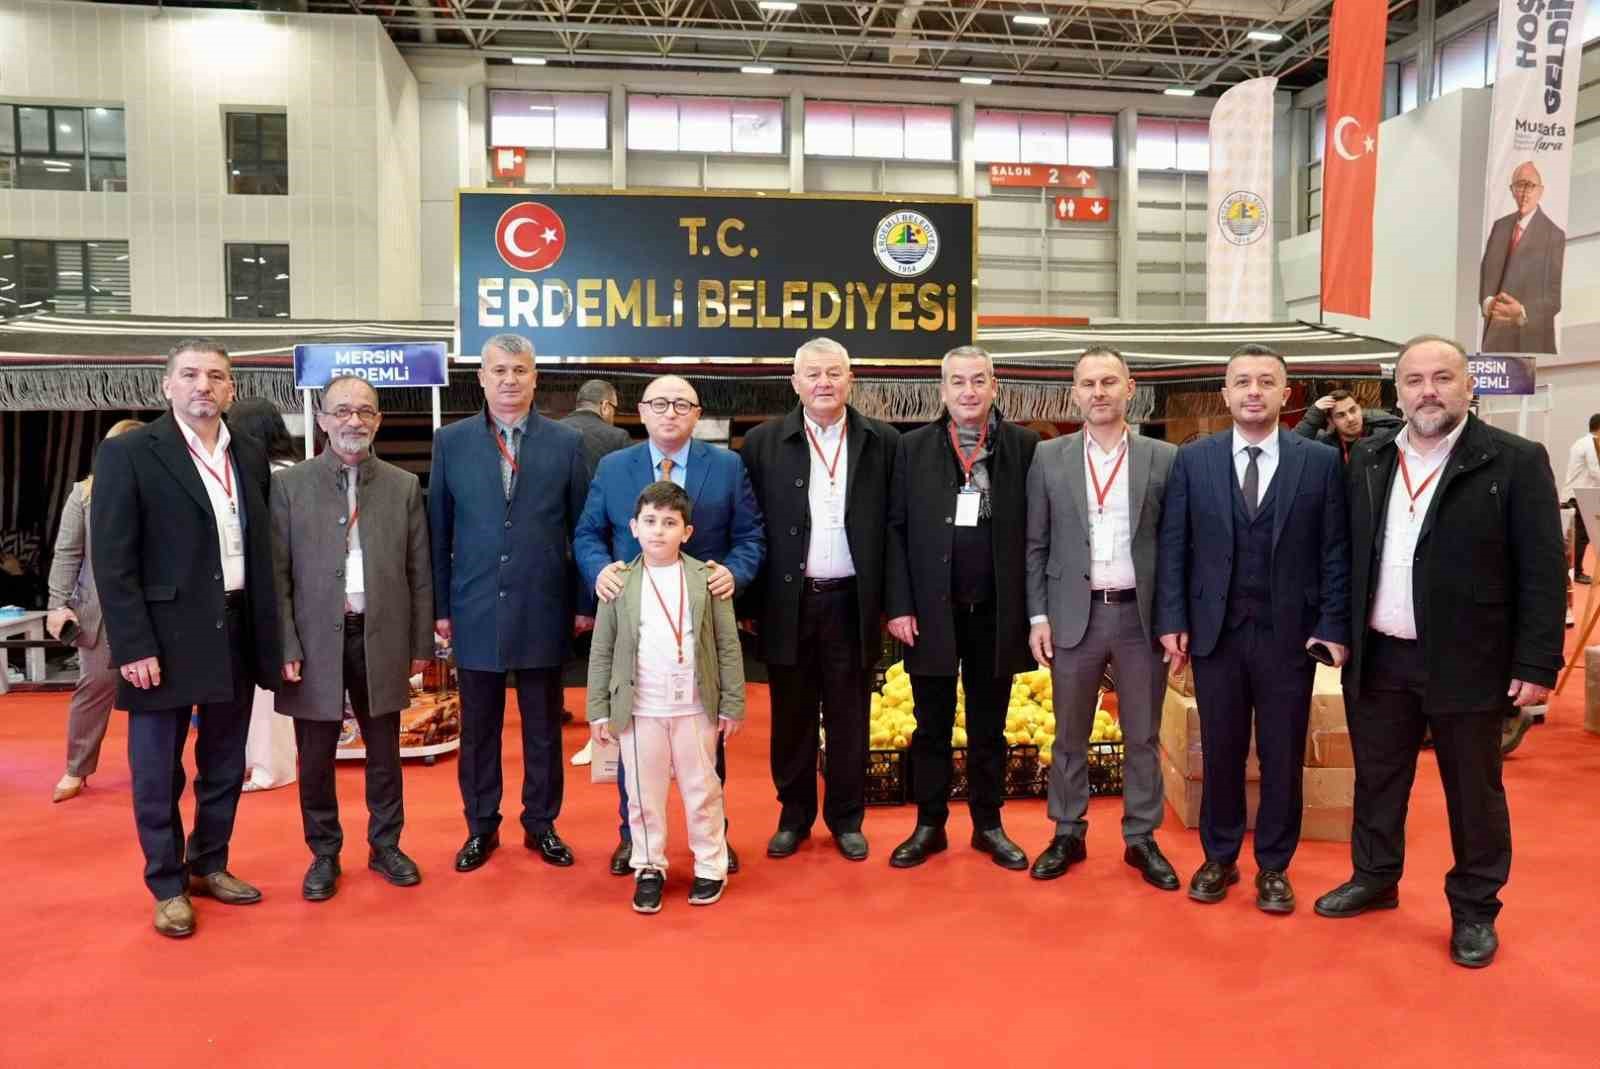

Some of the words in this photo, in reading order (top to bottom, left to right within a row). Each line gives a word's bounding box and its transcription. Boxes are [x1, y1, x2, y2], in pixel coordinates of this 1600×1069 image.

[991, 167, 1031, 176] SALON
[1048, 168, 1059, 184] 2
[679, 217, 759, 257] T.C.
